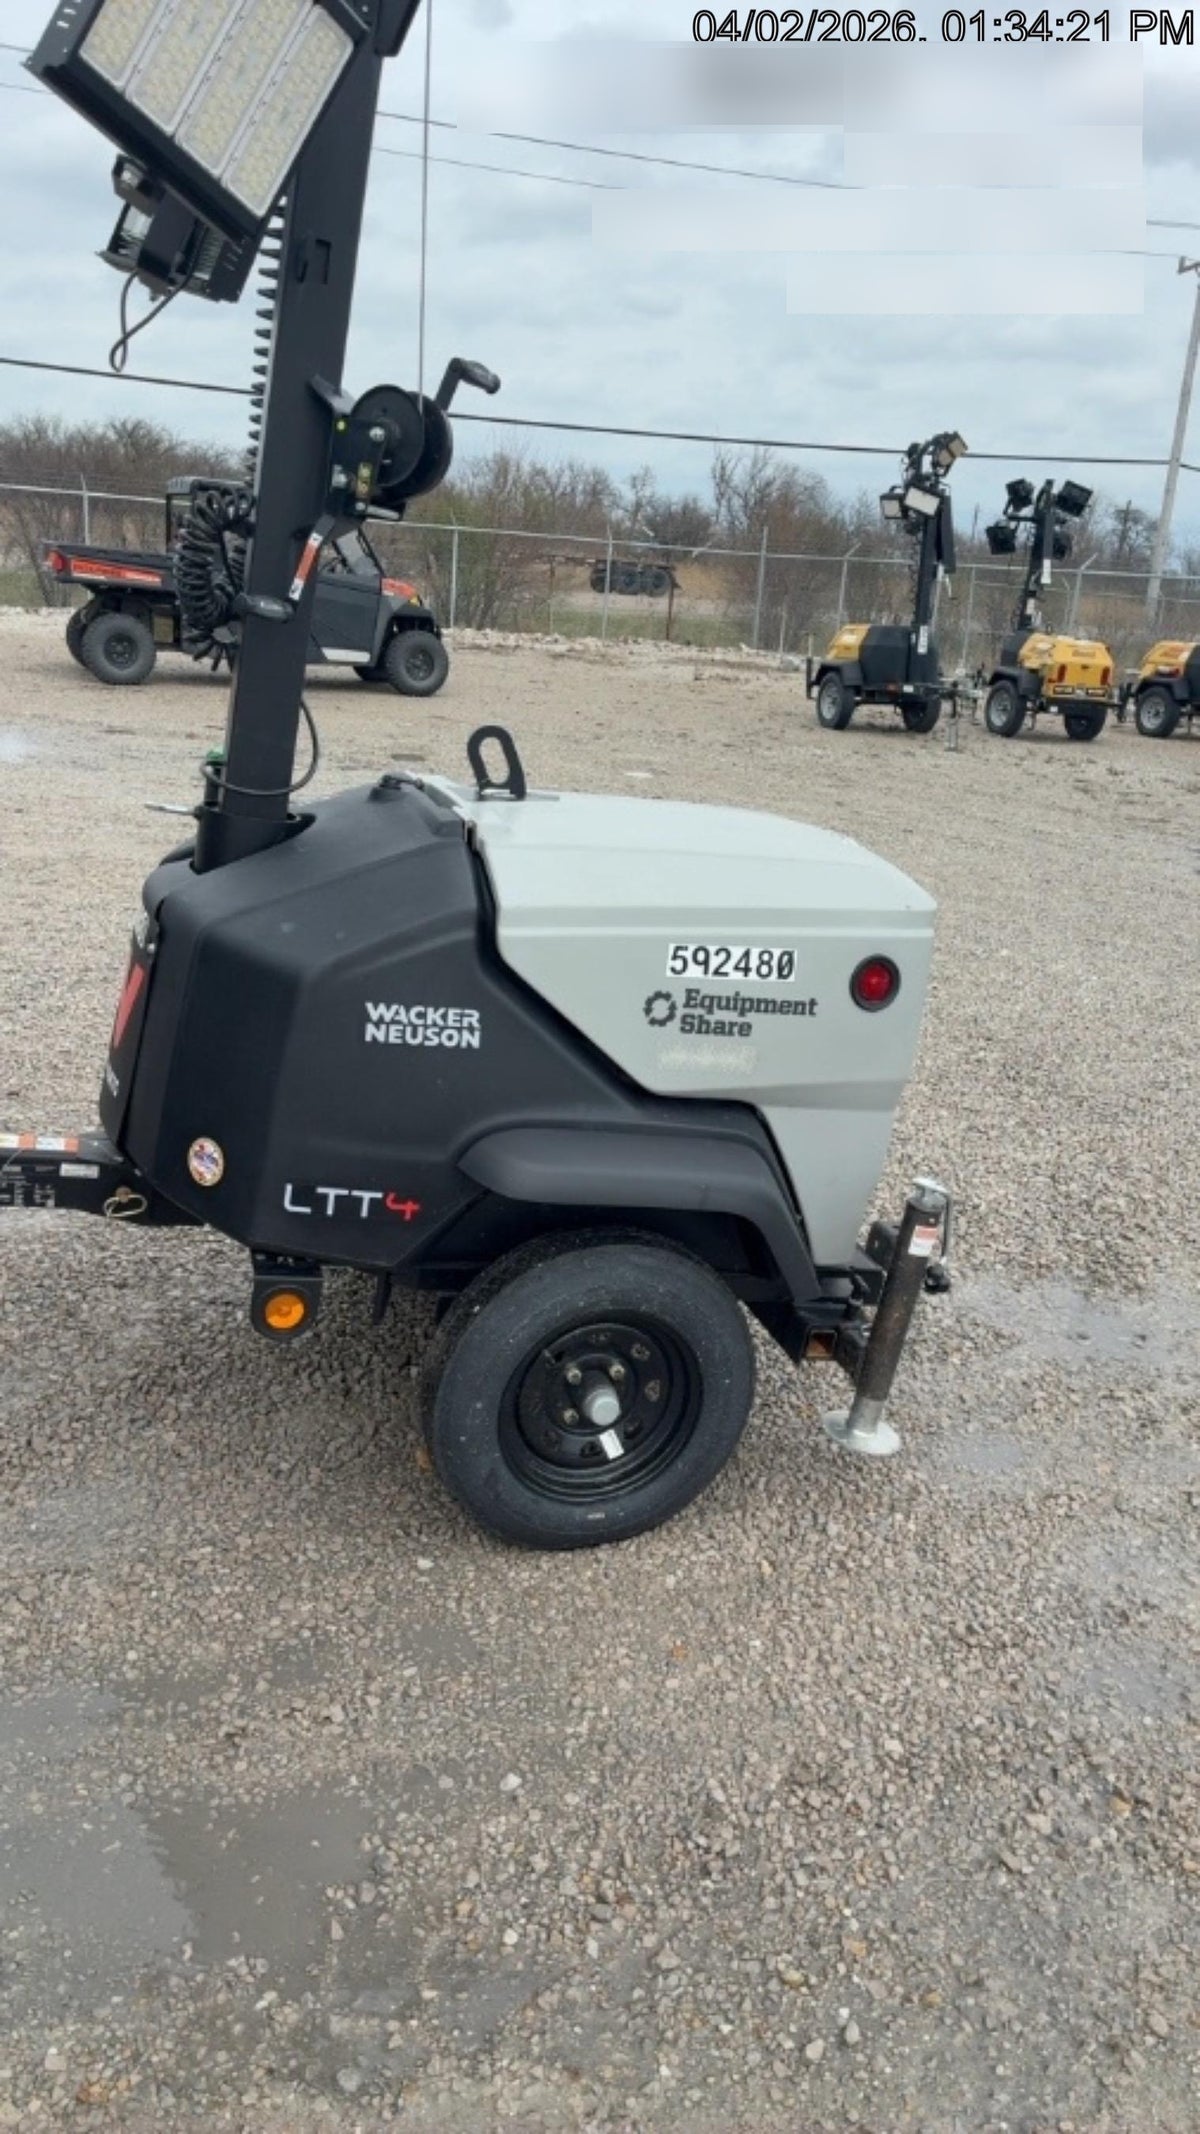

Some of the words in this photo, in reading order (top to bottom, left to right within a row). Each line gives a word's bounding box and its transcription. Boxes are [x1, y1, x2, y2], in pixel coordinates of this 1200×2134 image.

[669, 945, 796, 981] 592480
[364, 1001, 481, 1028] WACKER
[682, 988, 818, 1018] Equipment
[364, 1024, 482, 1049] NEUSON
[679, 1014, 753, 1038] Share
[283, 1183, 421, 1222] LTT4
